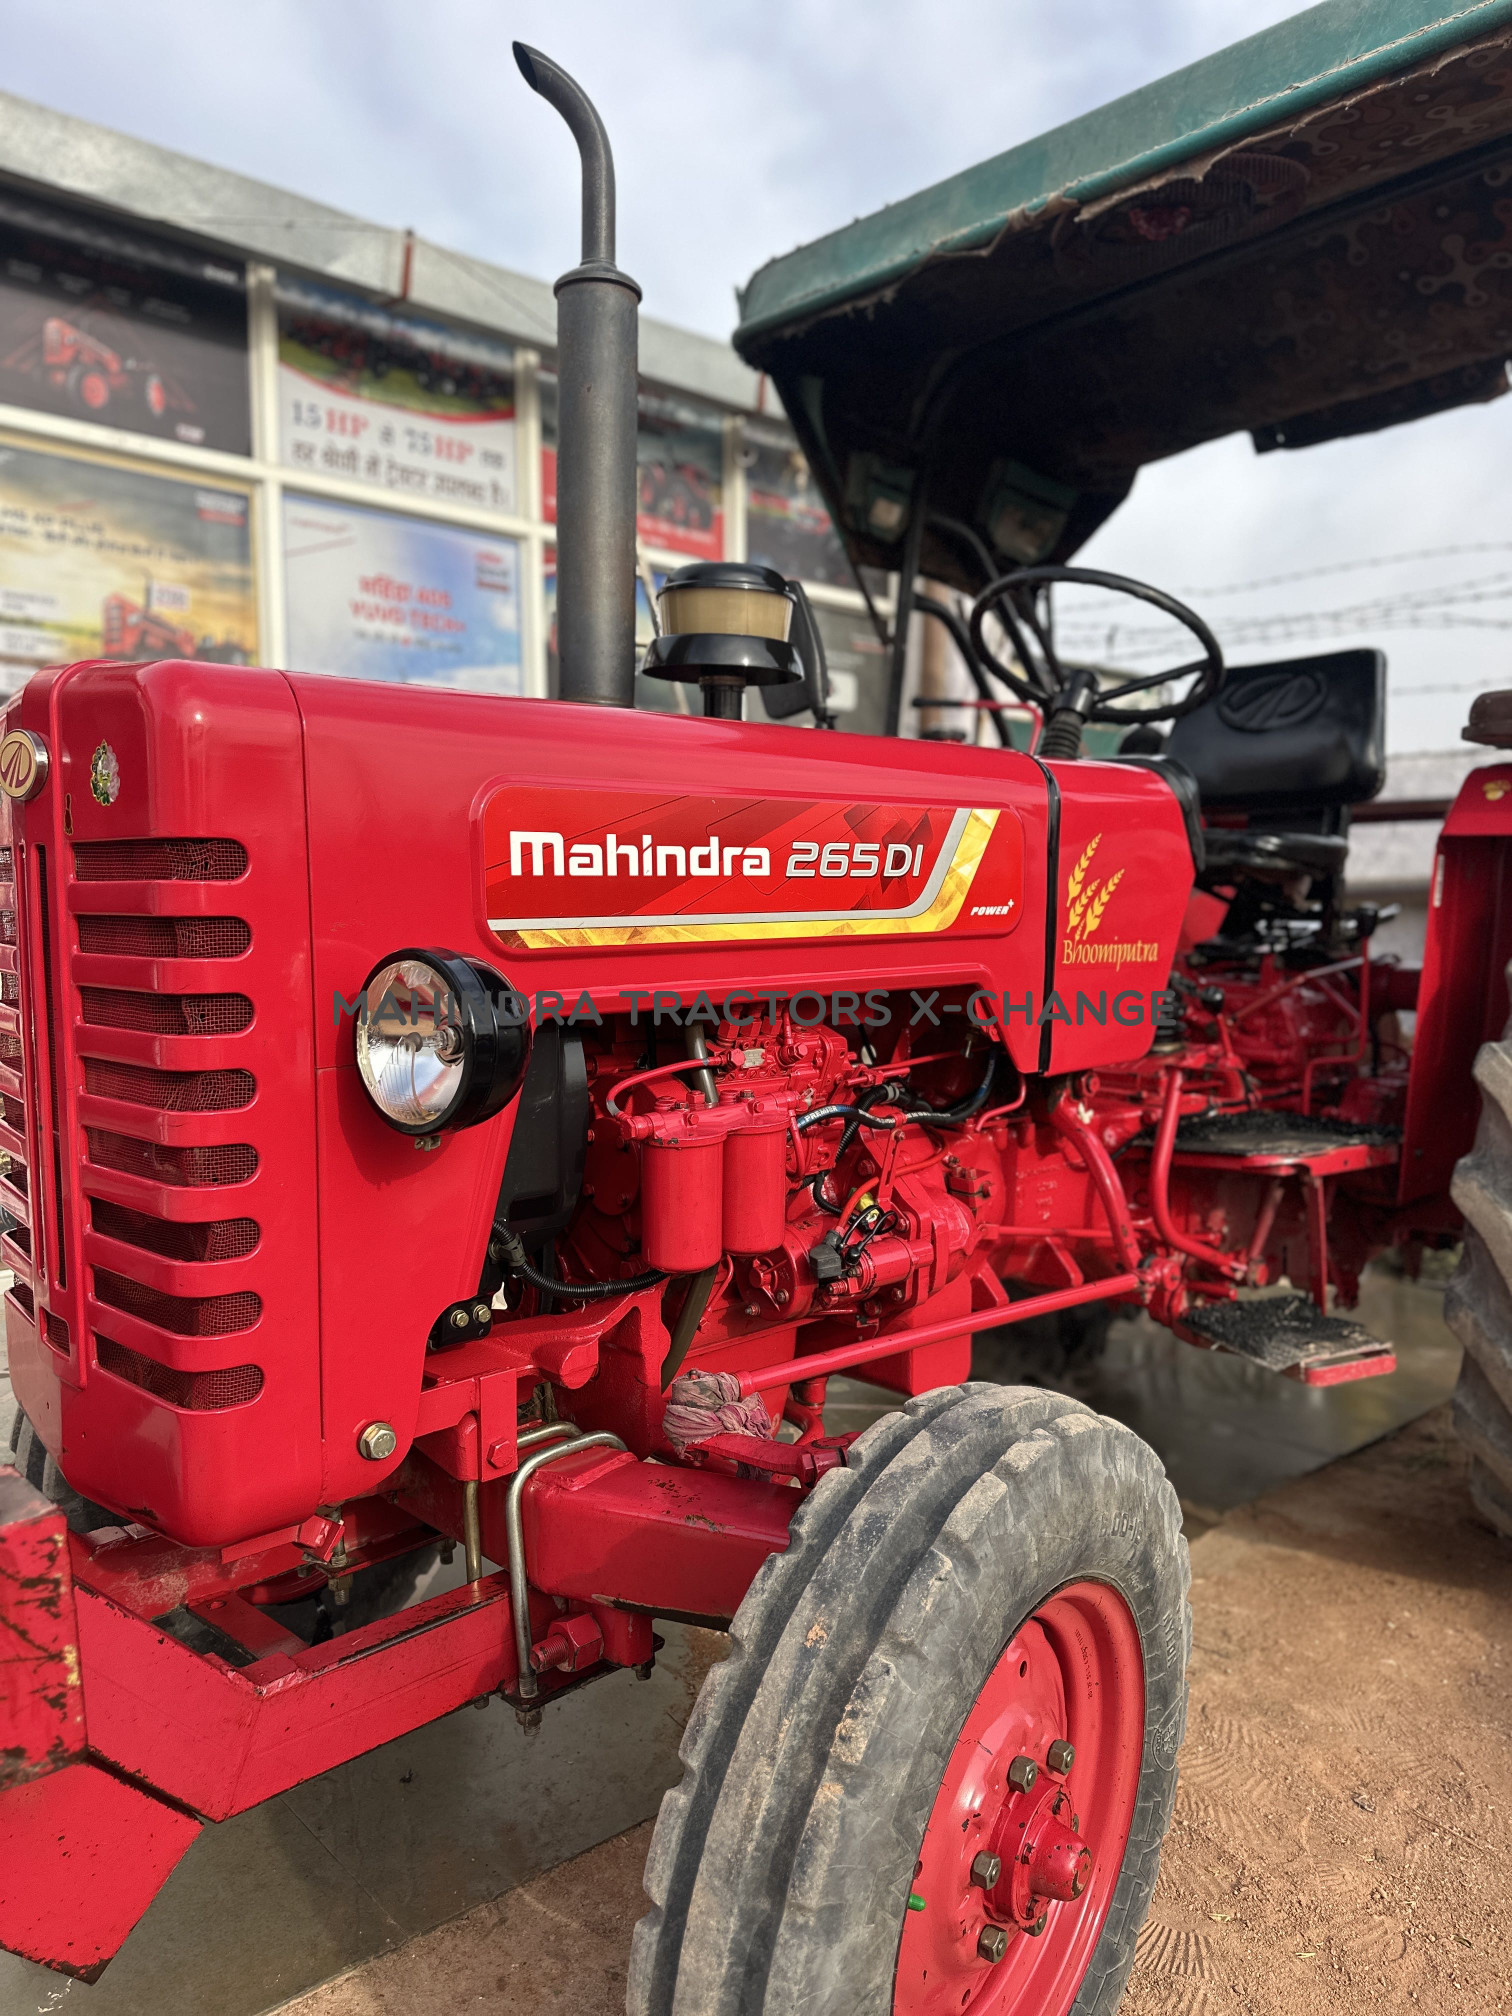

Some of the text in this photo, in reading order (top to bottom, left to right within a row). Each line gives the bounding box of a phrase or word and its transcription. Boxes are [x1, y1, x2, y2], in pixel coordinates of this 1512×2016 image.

[510, 831, 770, 876] Mahindra
[1062, 937, 1158, 972] Bhoomiputra
[804, 1105, 839, 1122] PREMIER
[1162, 1610, 1178, 1669] NYLON
